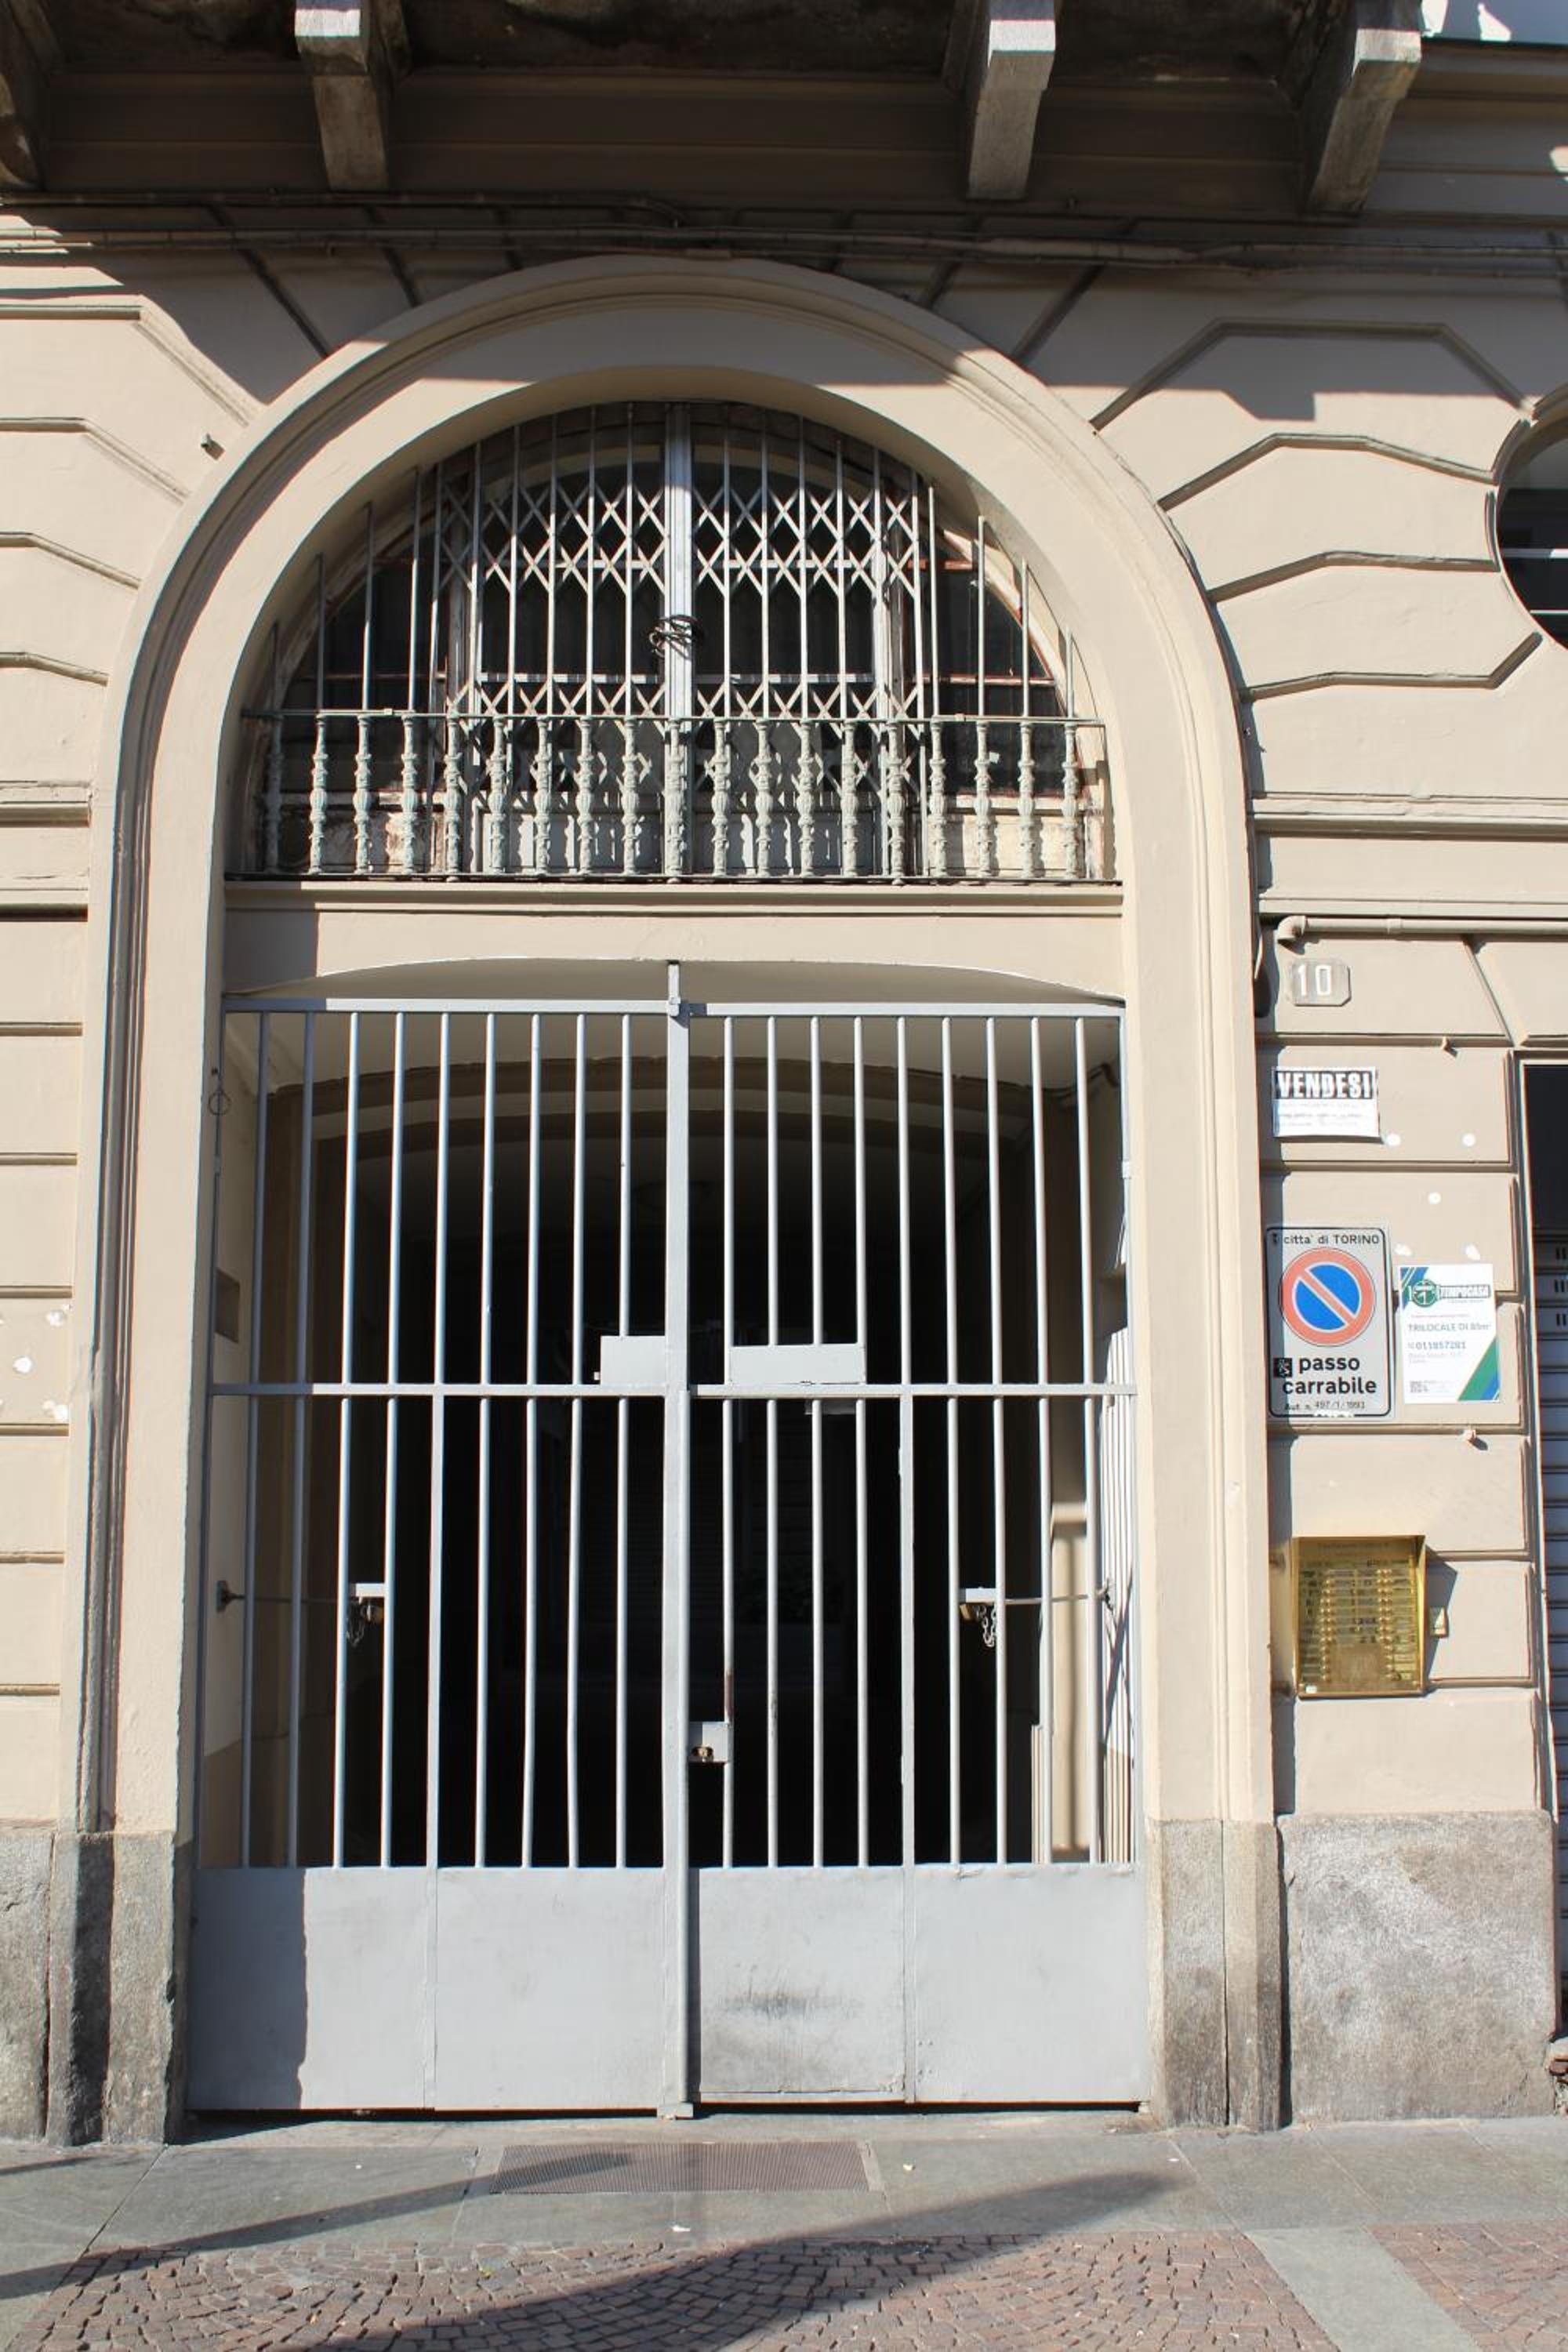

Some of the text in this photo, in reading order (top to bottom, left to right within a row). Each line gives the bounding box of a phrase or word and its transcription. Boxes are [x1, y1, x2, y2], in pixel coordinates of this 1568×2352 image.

[1298, 964, 1331, 996] 10
[1277, 1072, 1370, 1098] VENDESI
[1318, 1234, 1329, 1244] di
[1334, 1234, 1380, 1245] TORINO
[1299, 1357, 1360, 1374] passo
[1283, 1377, 1377, 1395] carrabile
